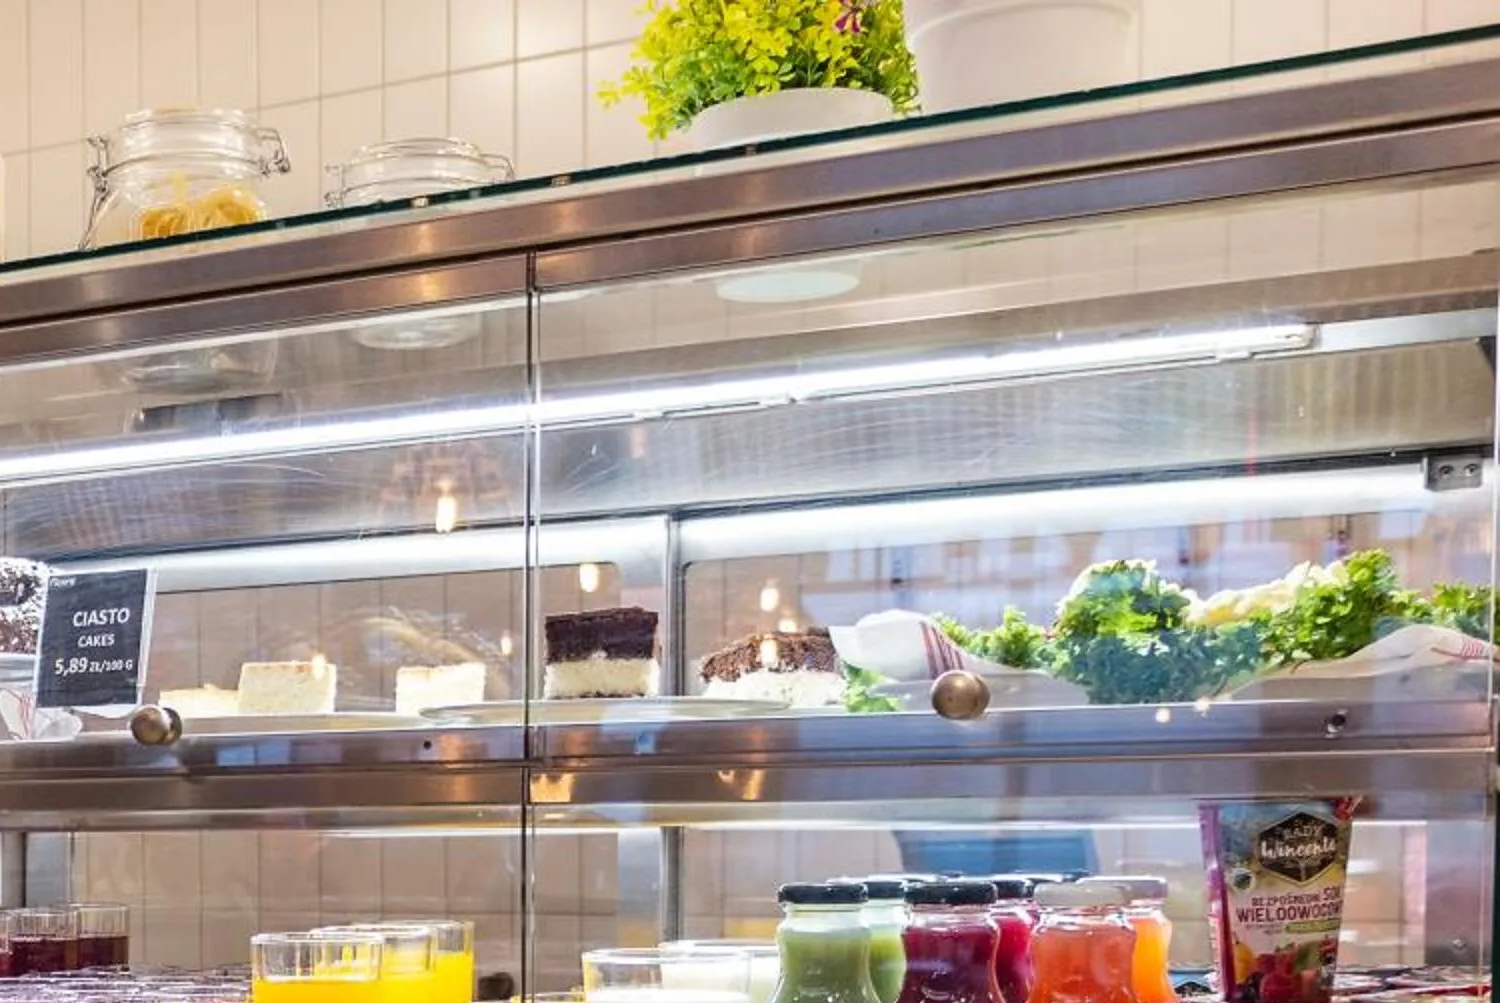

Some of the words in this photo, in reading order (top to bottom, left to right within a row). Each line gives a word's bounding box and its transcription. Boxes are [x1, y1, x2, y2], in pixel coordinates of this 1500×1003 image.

[72, 607, 130, 627] CIASTO
[77, 633, 115, 648] CAKES
[55, 657, 88, 677] 5,89
[125, 659, 133, 671] G
[1236, 901, 1341, 923] WIELOOWOCOW
